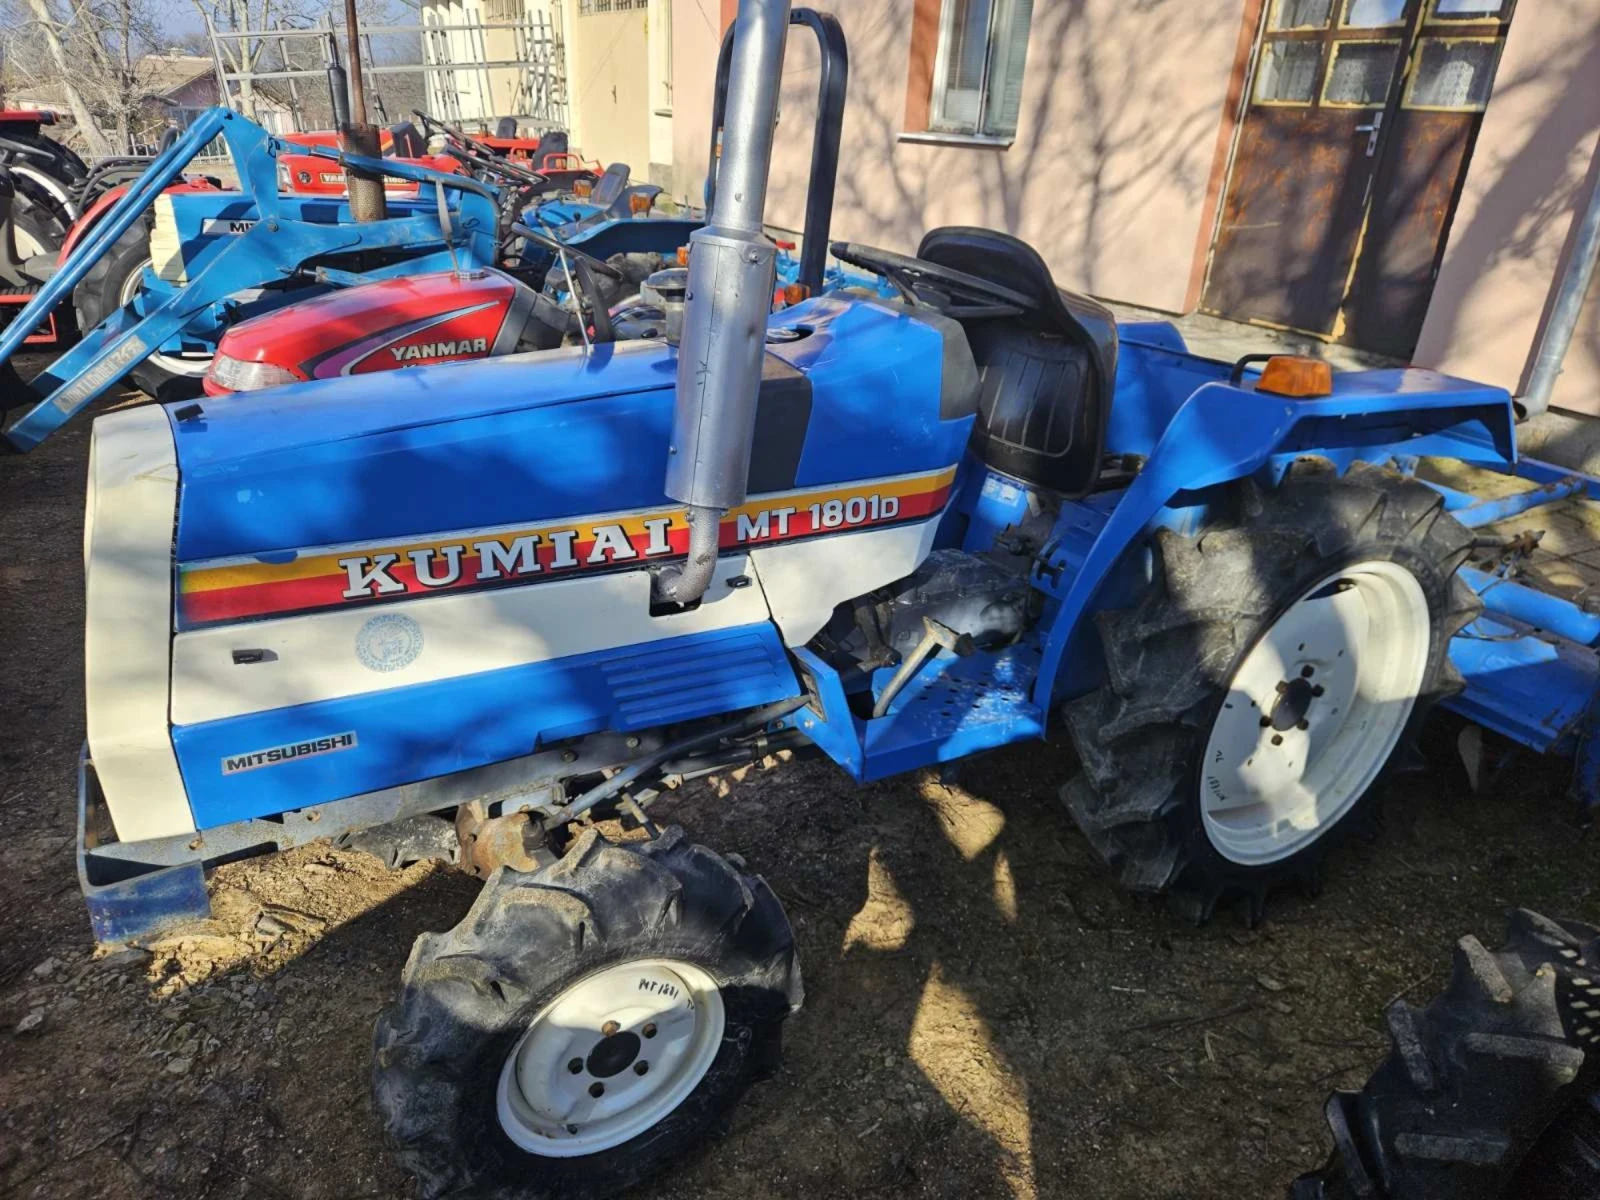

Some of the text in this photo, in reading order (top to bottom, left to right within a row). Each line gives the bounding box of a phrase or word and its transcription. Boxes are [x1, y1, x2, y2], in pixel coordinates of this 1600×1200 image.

[391, 338, 486, 361] YANMAR
[338, 494, 899, 599] KUMIAI MT 1801D
[226, 734, 353, 771] MITSUBISHI
